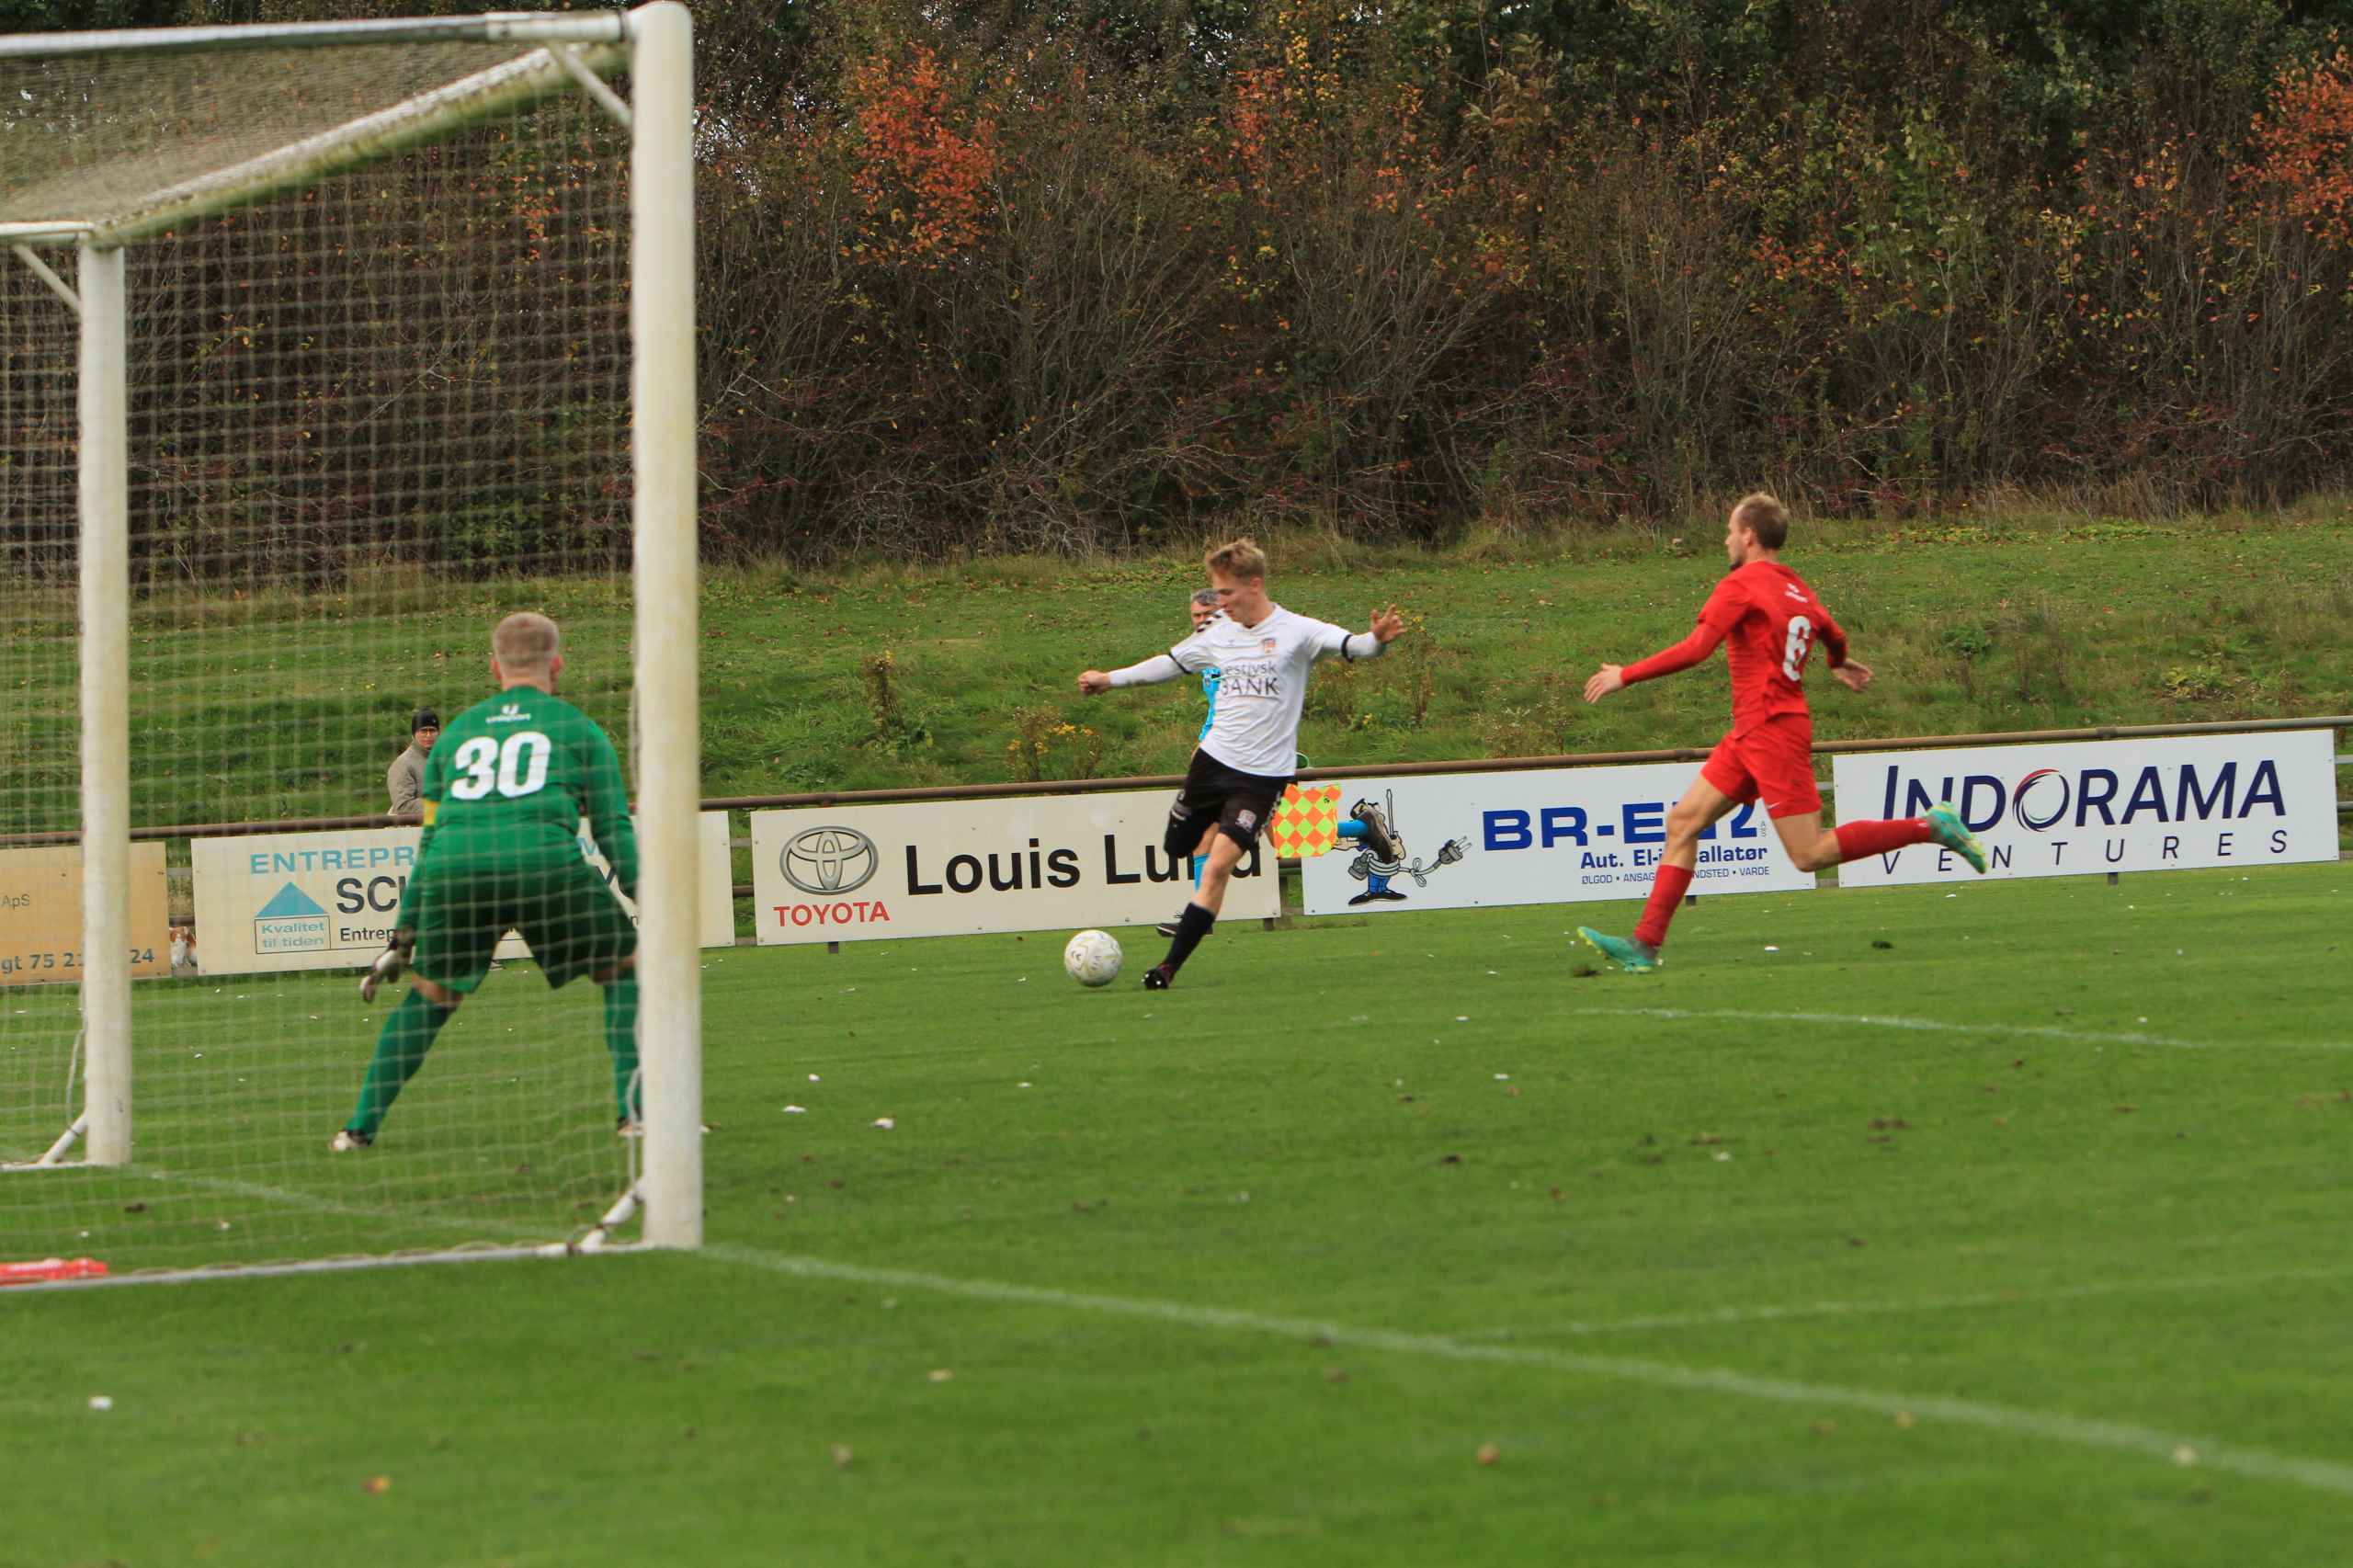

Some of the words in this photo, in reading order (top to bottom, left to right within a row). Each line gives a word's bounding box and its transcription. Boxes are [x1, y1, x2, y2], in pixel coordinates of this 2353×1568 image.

[1782, 615, 1811, 682] 6
[450, 731, 551, 801] 30
[1882, 759, 2287, 833] INDORAMA
[1483, 801, 1757, 851] BR-E2
[249, 846, 415, 875] ENTREPR
[906, 837, 1081, 897] Louis
[1104, 827, 1262, 885] Lud
[1580, 851, 1624, 869] Aut.
[1633, 845, 1768, 868] El-iallatør
[1882, 829, 2289, 875] VENTURES
[1581, 874, 1613, 885] ØLGOD
[1623, 872, 1655, 883] ANSAG
[1693, 868, 1730, 880] NDSTED
[1739, 866, 1770, 877] VARDE
[261, 922, 324, 935] Kvalitet
[773, 901, 891, 927] TOYOTA
[262, 937, 277, 949] til
[281, 937, 324, 949] tiden
[29, 953, 55, 970] 75
[130, 949, 155, 964] 24
